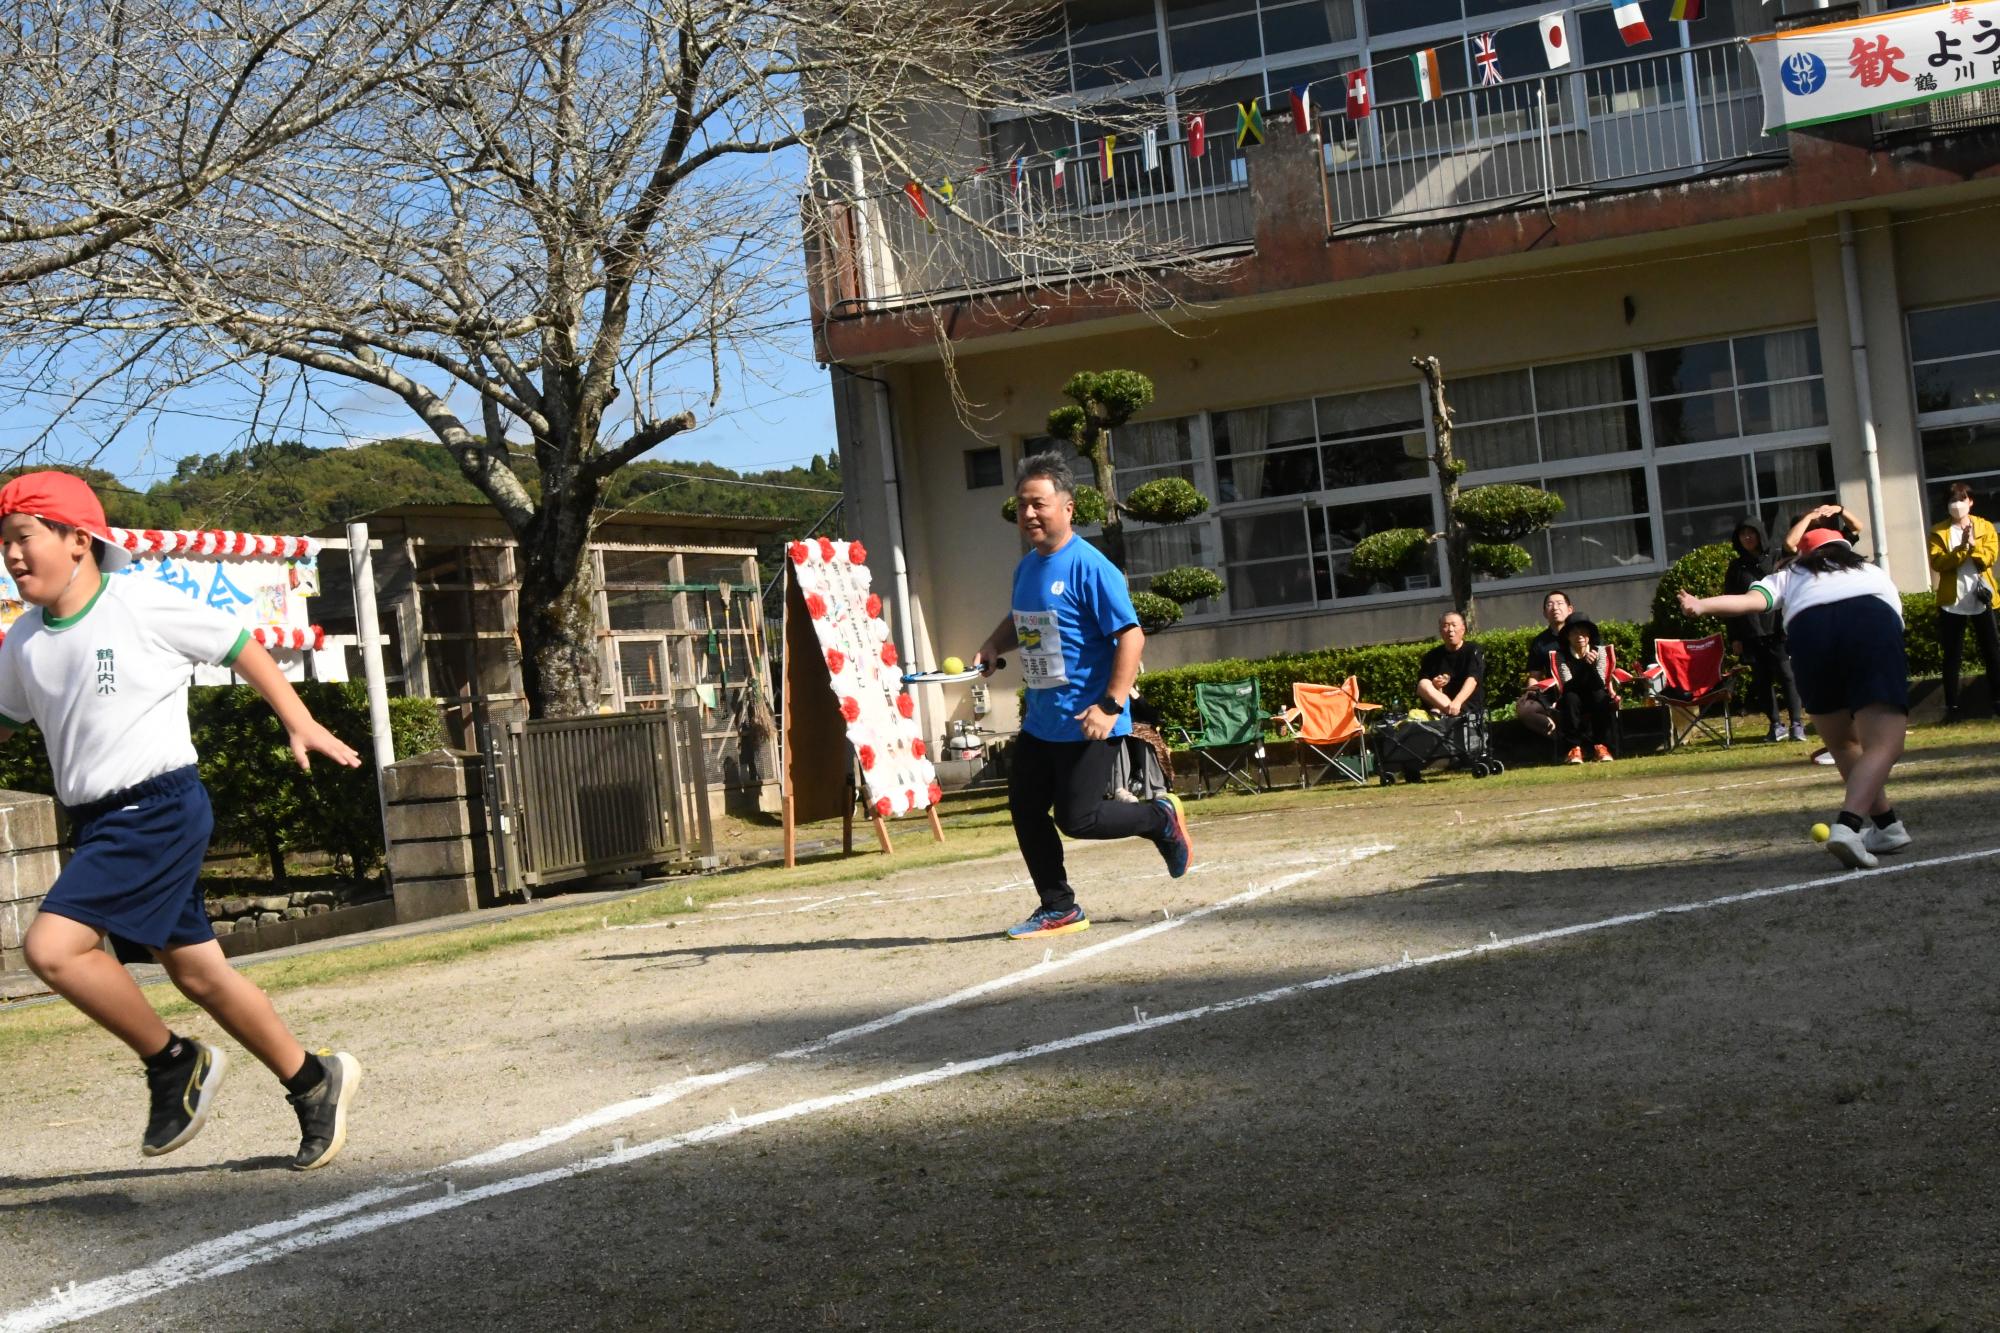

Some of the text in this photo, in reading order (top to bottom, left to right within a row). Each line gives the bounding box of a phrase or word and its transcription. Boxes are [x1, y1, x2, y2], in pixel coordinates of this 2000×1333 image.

[1849, 34, 1911, 88] 歓
[96, 647, 117, 695] 鶴川内小
